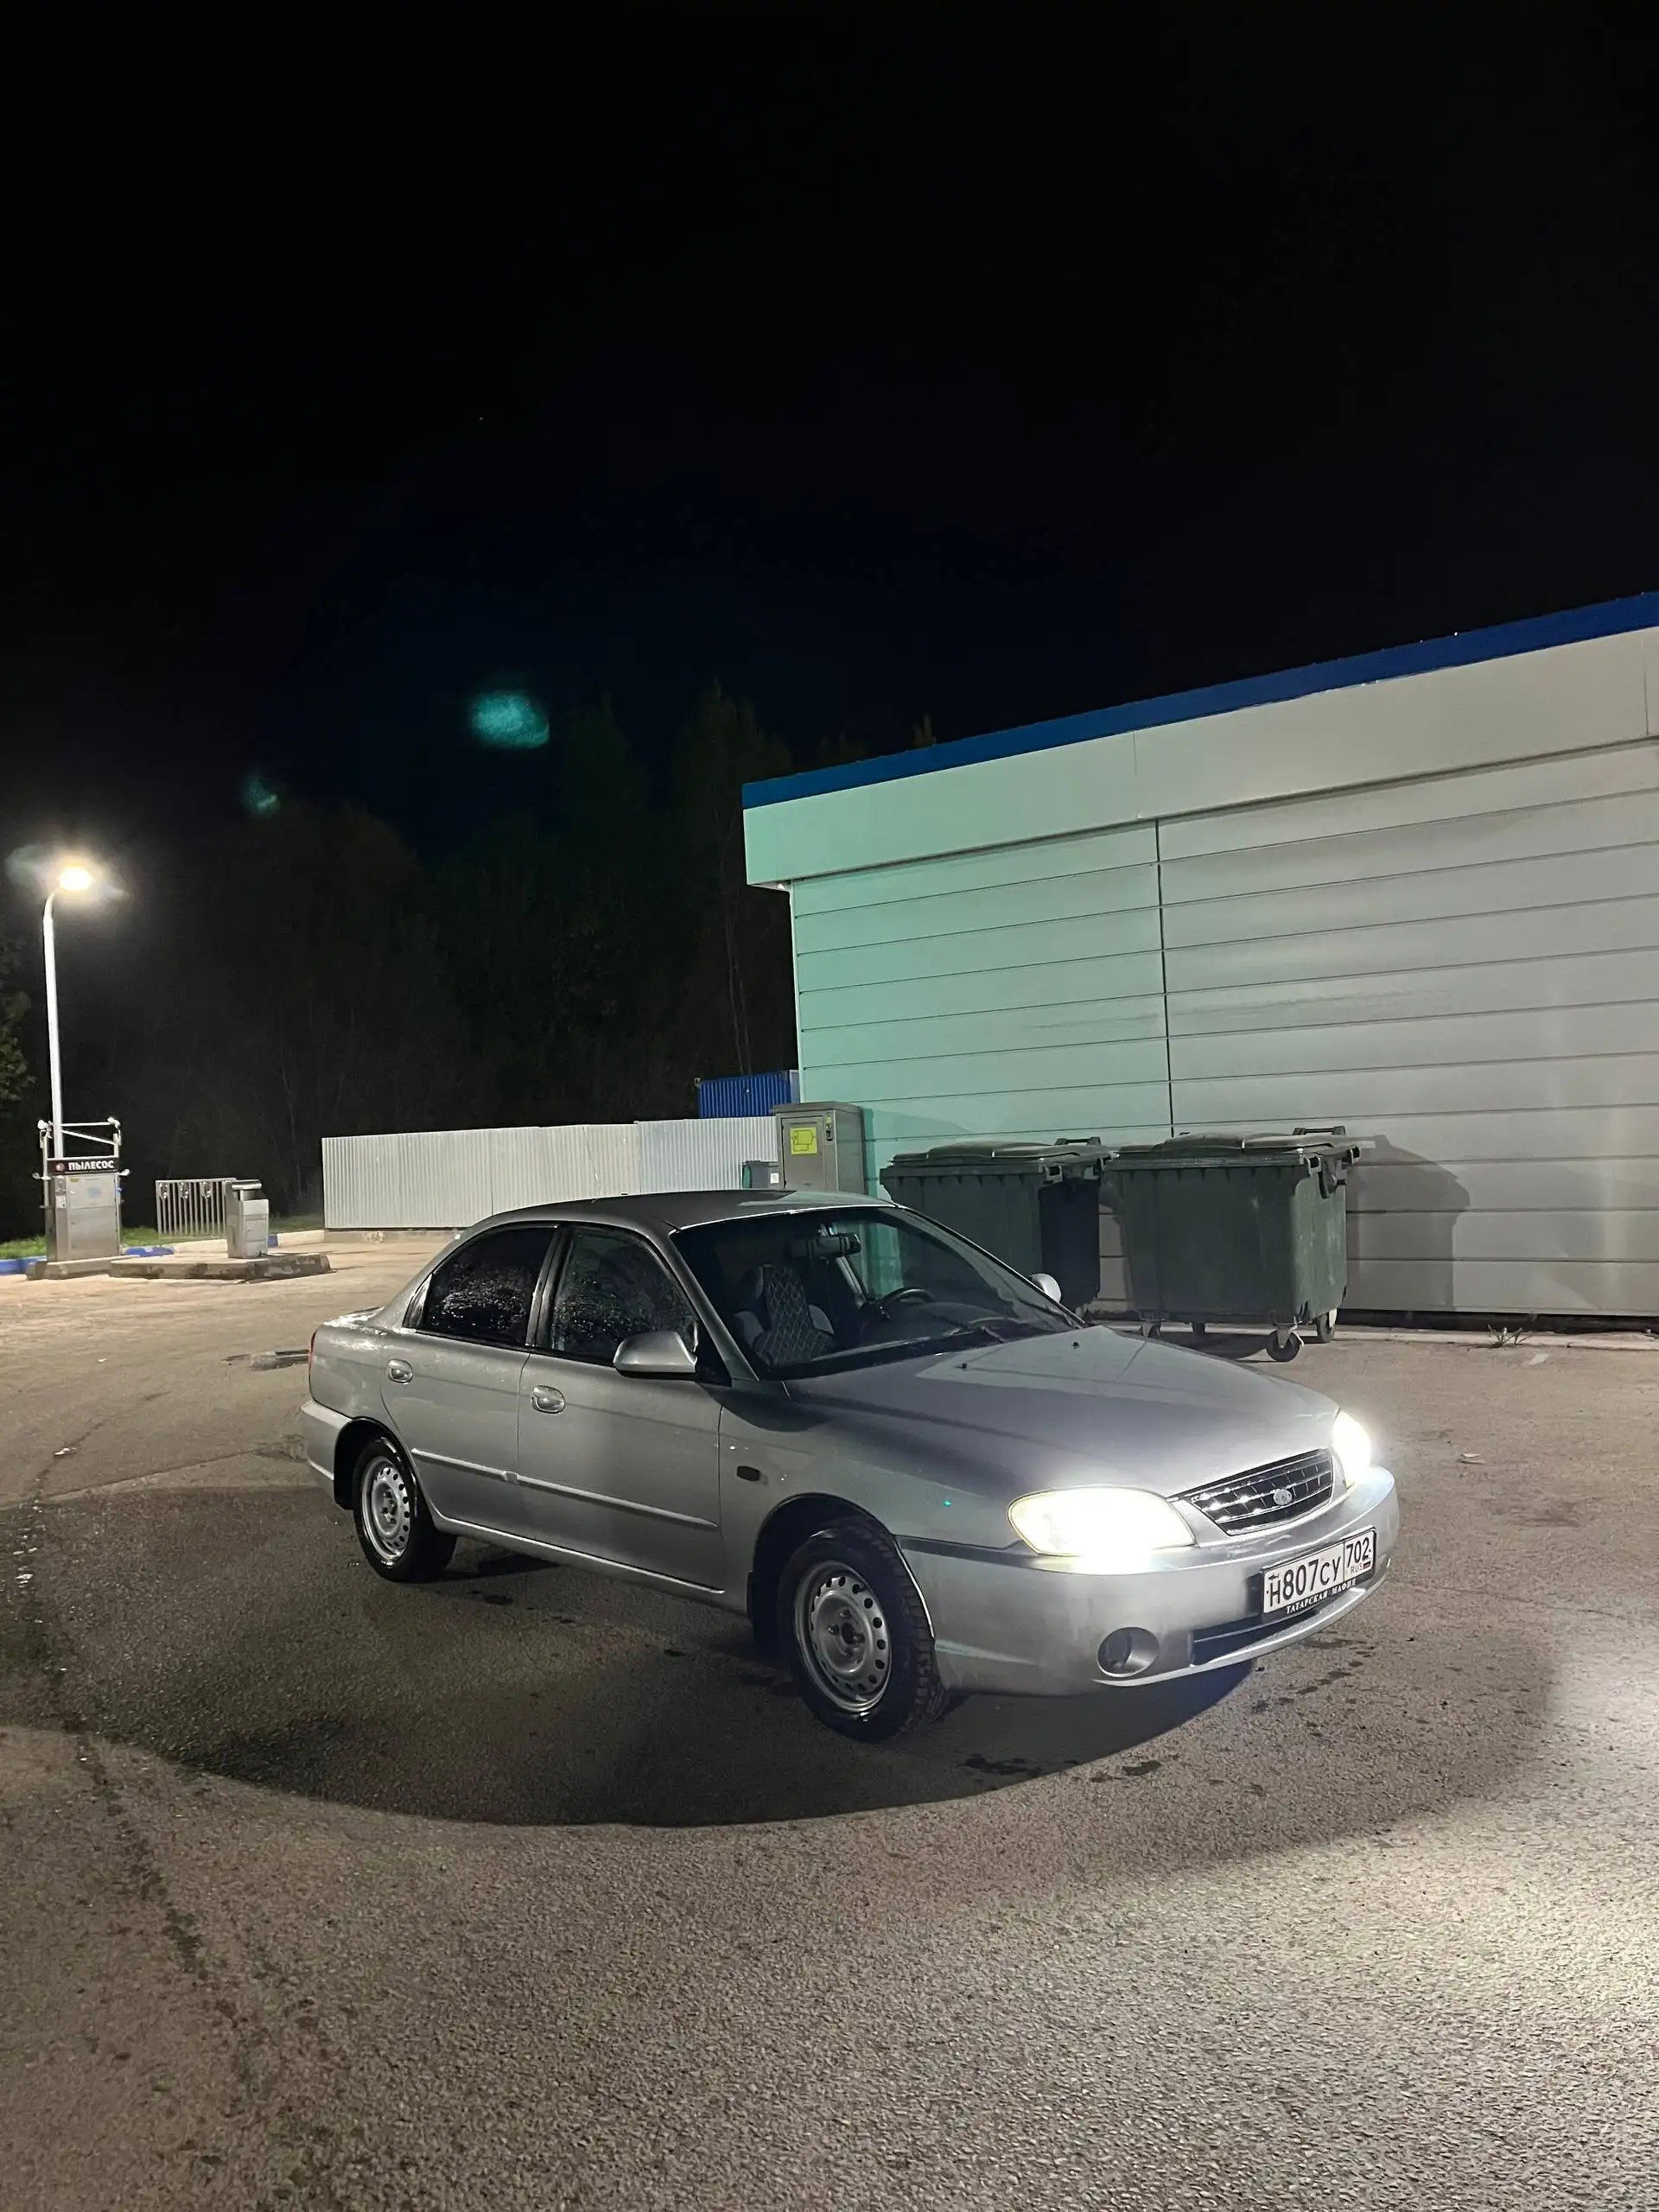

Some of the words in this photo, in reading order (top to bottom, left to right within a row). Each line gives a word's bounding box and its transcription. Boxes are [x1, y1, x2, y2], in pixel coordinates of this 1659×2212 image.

[68, 1160, 114, 1171] ПЫЛЕСОС
[1346, 1537, 1370, 1568] 702
[1351, 1563, 1363, 1573] RUS
[1286, 1591, 1328, 1614] ТАТАРСКАЯ
